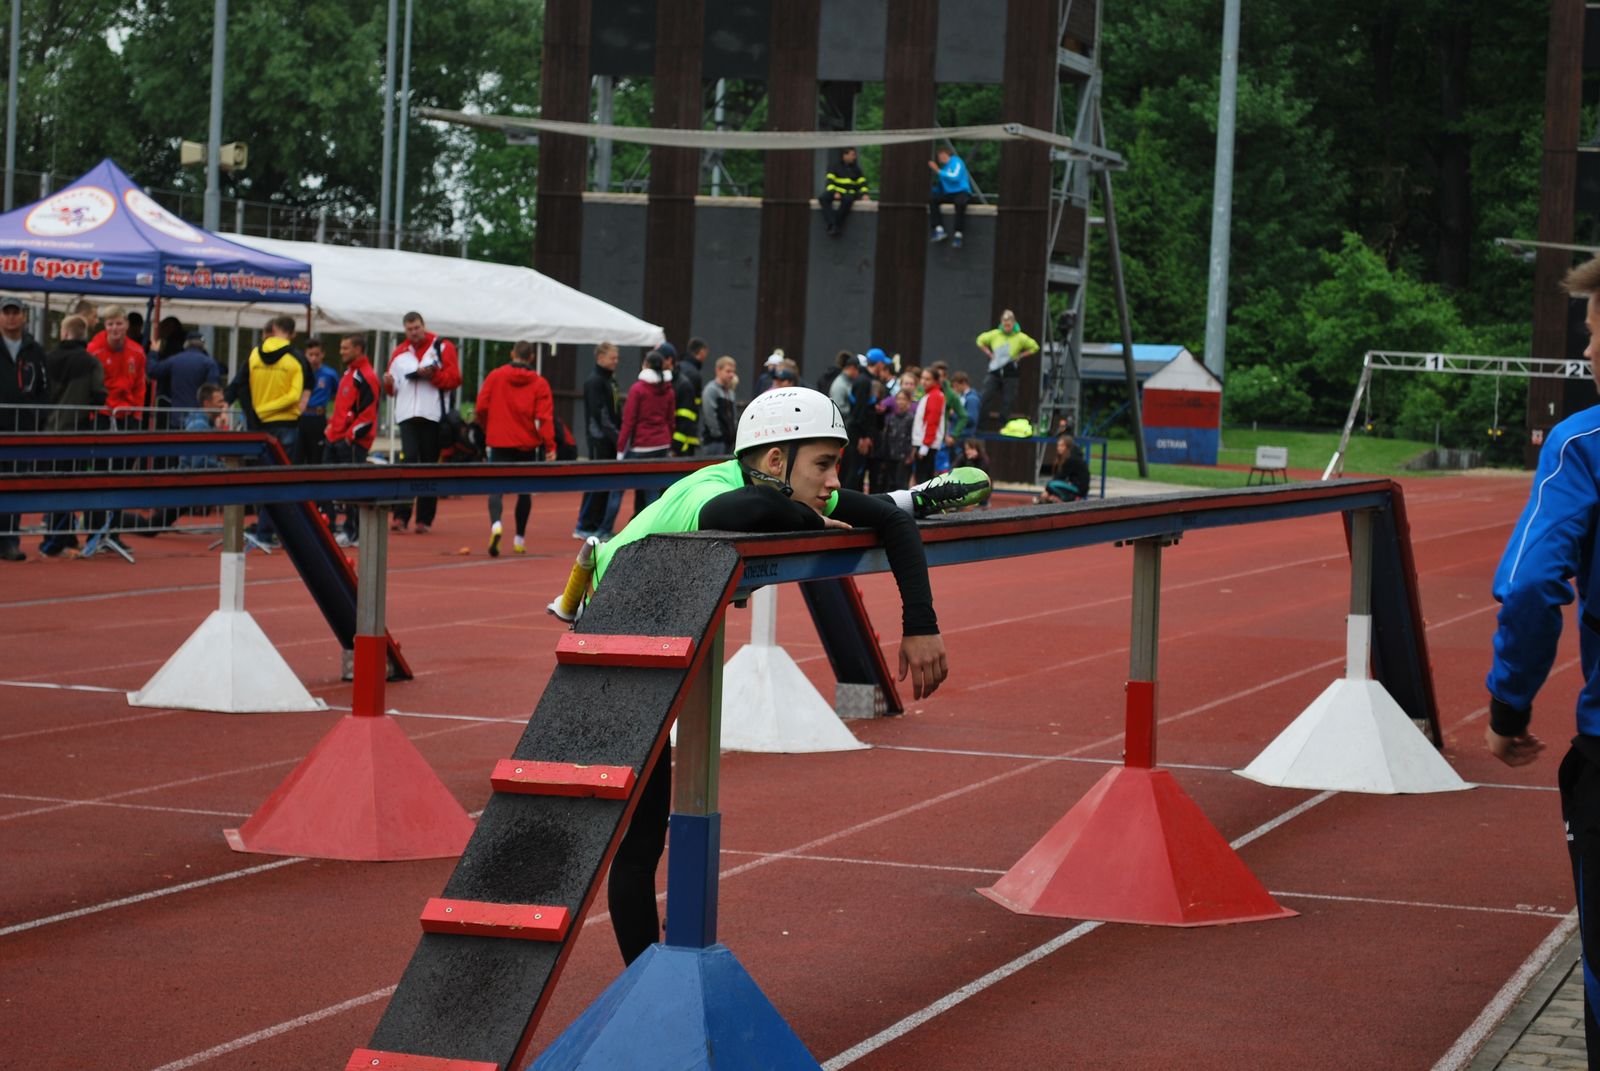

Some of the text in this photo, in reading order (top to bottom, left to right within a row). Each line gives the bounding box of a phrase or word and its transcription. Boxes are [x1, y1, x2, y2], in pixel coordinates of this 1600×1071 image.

[33, 257, 103, 279] sport
[1431, 356, 1439, 370] 1
[1569, 363, 1581, 377] 2
[1548, 402, 1555, 416] 1
[1156, 438, 1187, 449] OSTRAVA
